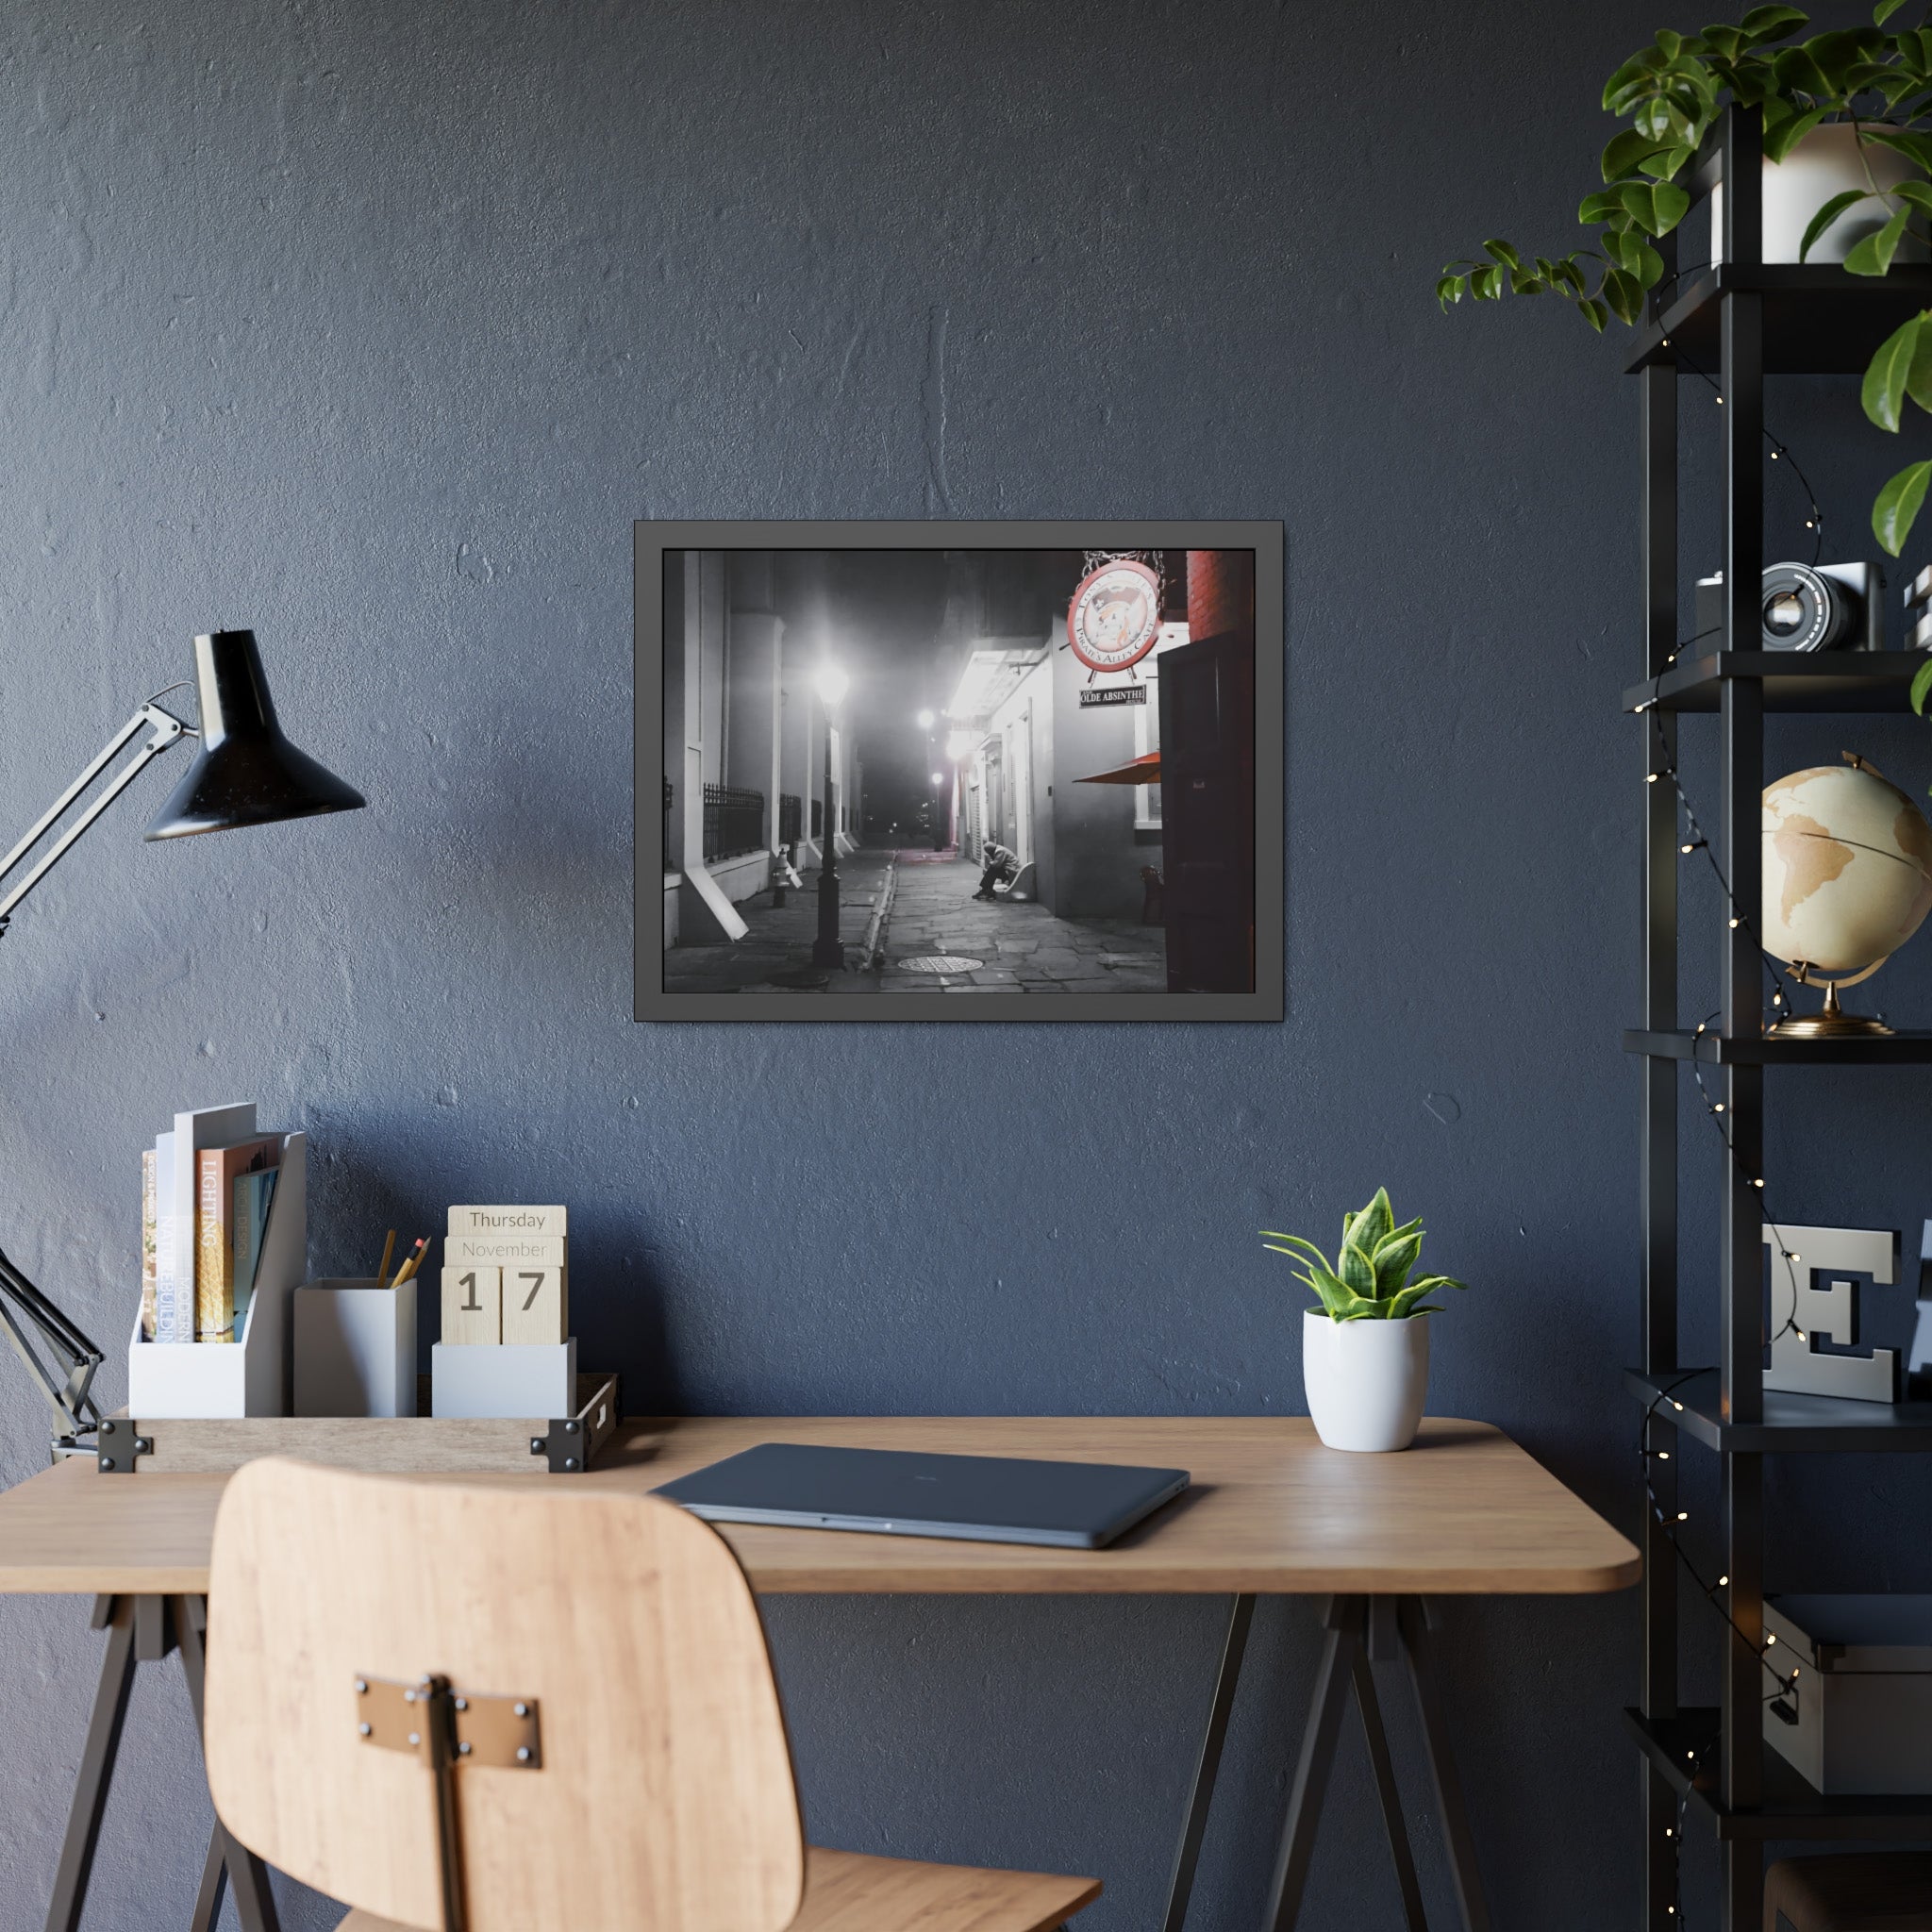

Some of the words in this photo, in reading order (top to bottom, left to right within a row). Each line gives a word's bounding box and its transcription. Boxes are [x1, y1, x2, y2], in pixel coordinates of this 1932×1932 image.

[1080, 692, 1102, 703] OLDE
[1103, 690, 1143, 702] ABSINTHE
[202, 1160, 217, 1247] LIGHTING
[470, 1212, 546, 1229] Thursday
[238, 1216, 248, 1259] DESIGN
[462, 1241, 547, 1257] November
[178, 1276, 192, 1343] MODERN
